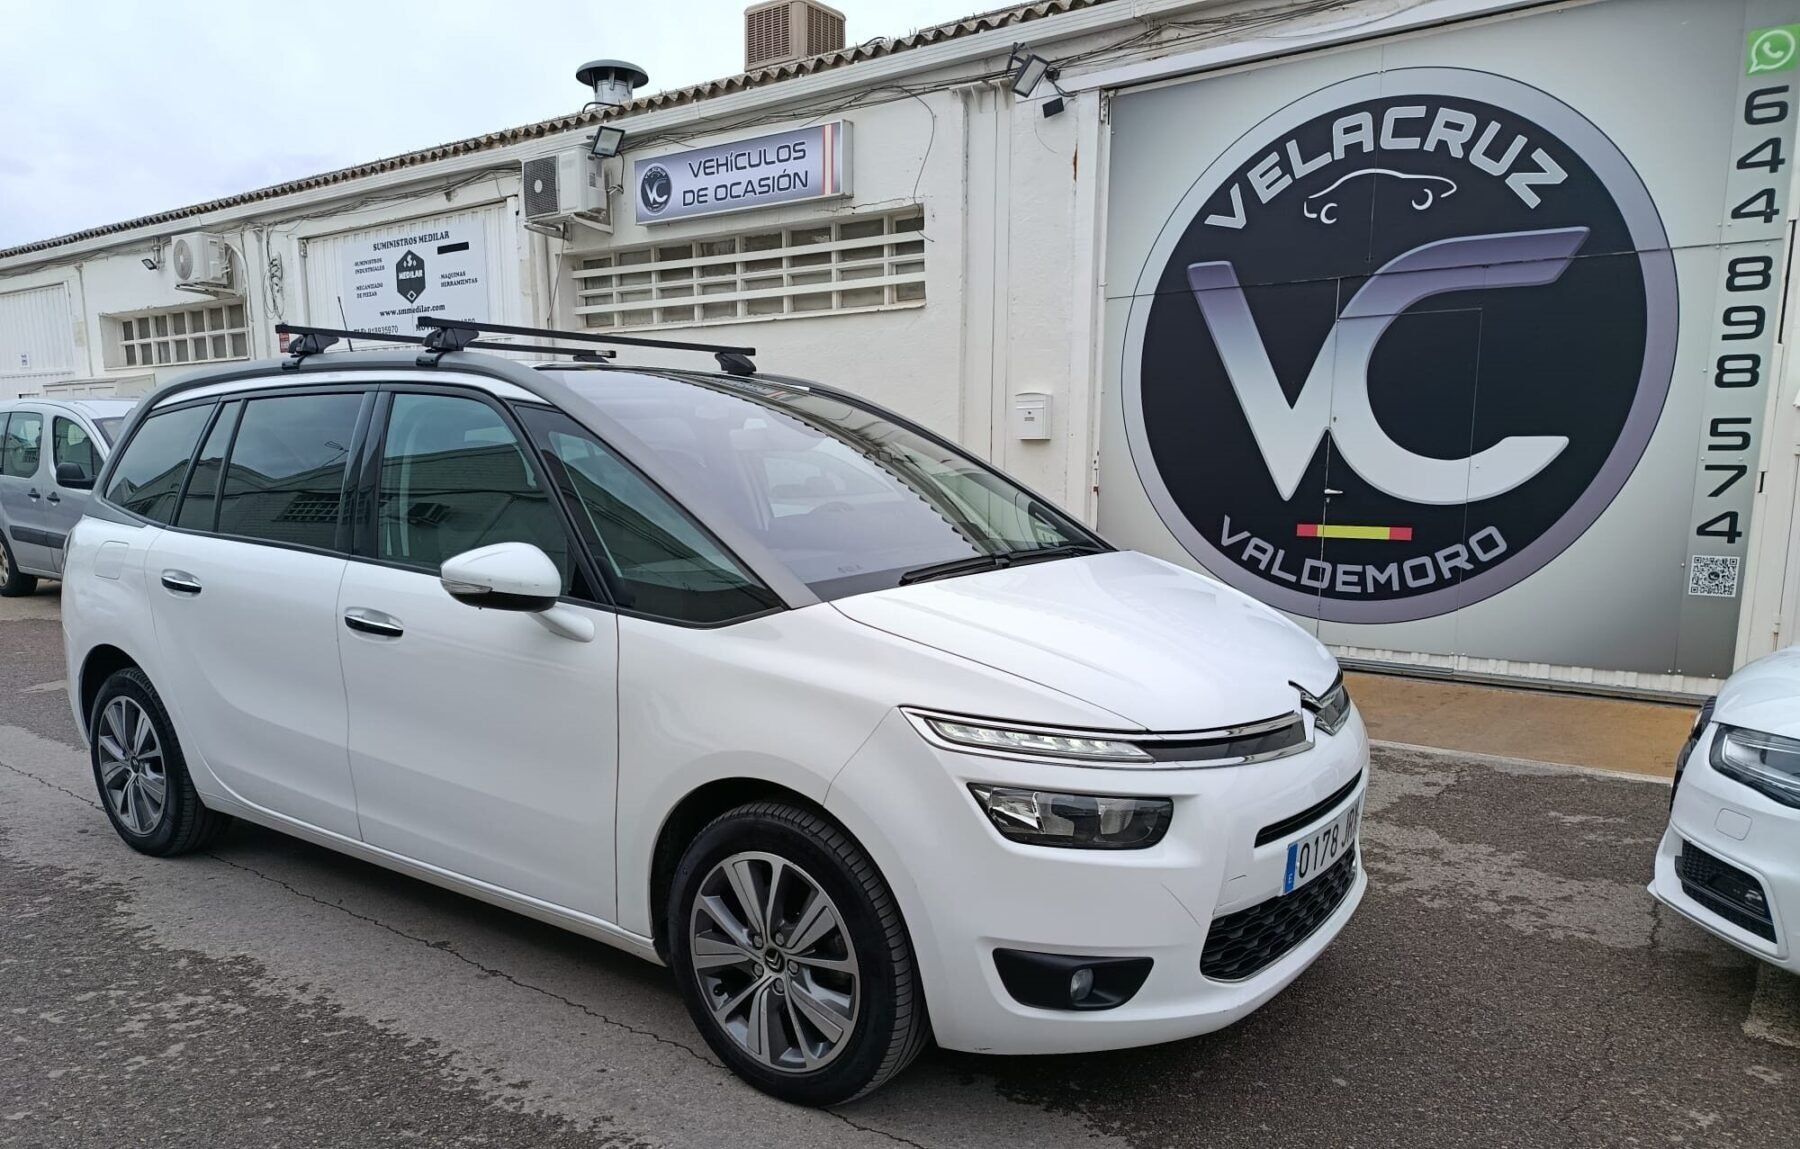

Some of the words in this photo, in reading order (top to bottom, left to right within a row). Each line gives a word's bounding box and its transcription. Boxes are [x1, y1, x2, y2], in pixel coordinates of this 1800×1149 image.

[682, 186, 708, 207] DE
[714, 168, 808, 202] OCASIÓN
[1204, 105, 1569, 230] VELACRUZ
[373, 237, 418, 251] SUMINISTROS
[418, 230, 450, 243] MEDILAR
[1186, 226, 1591, 506] VC
[1222, 514, 1508, 593] VALDEMORO
[1298, 823, 1339, 878] 0178
